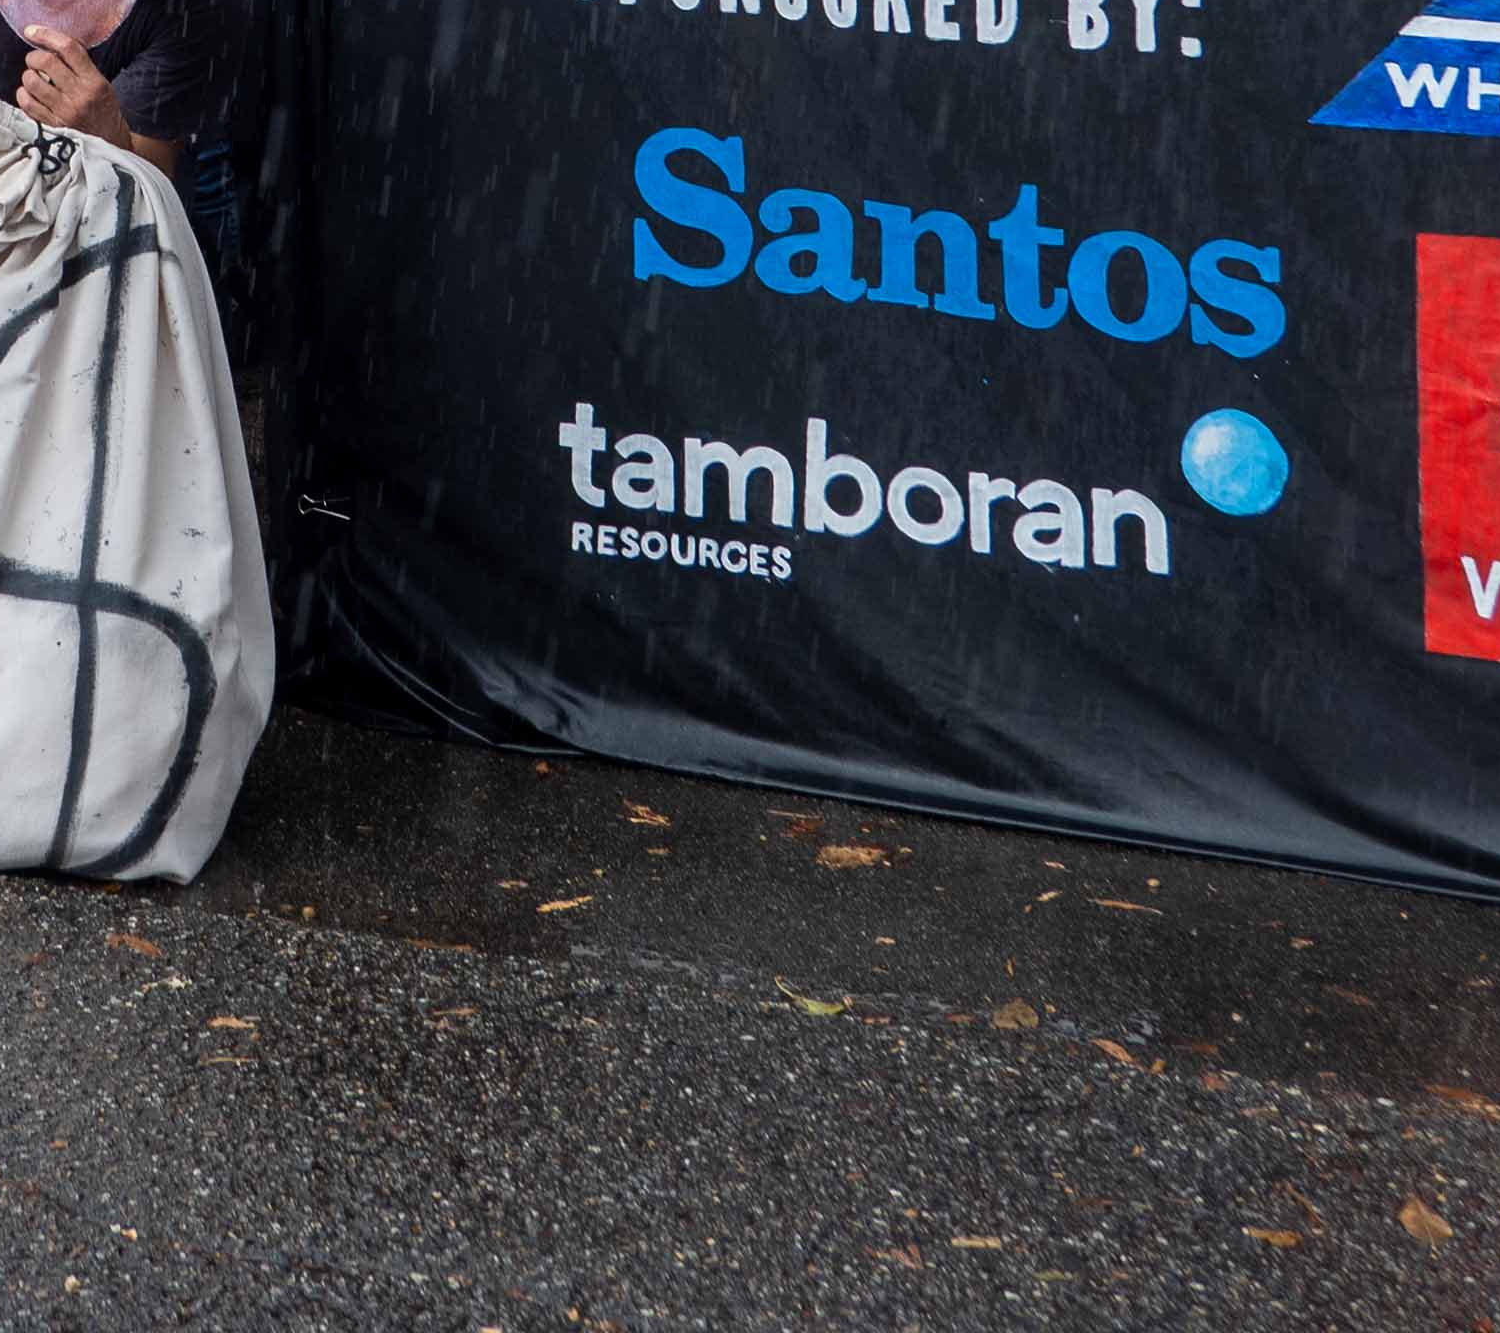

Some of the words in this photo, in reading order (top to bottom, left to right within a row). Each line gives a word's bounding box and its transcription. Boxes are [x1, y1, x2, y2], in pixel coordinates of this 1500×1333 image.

[632, 126, 1287, 359] Santos
[559, 401, 1171, 575] tamboran
[570, 520, 793, 581] RESOURCES
